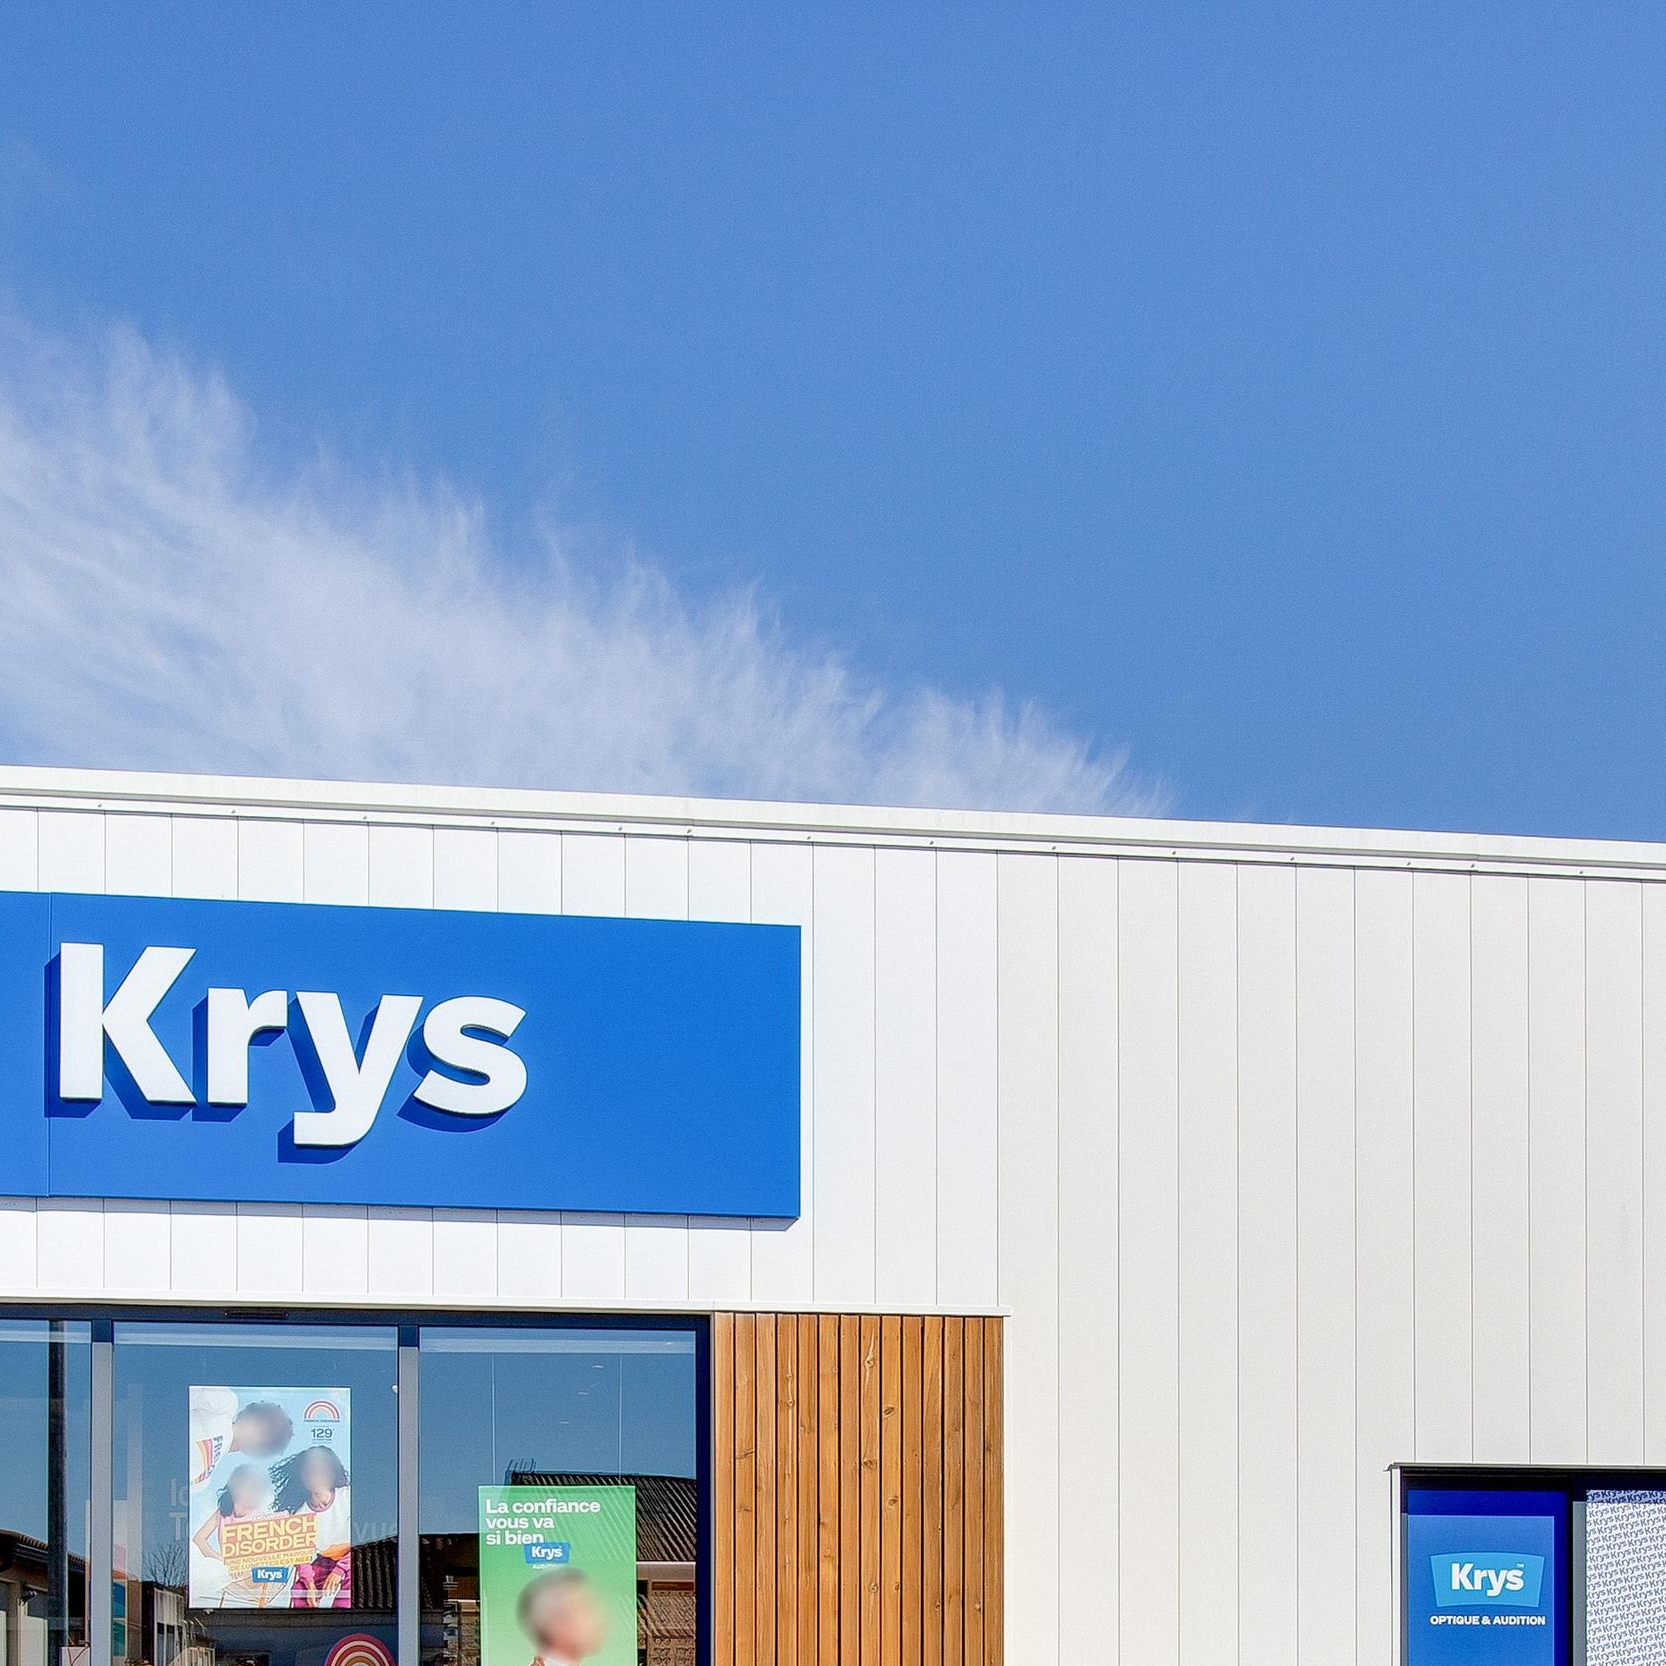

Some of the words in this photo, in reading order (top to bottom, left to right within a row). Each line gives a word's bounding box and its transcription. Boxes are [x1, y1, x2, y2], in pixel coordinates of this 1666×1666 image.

[59, 941, 529, 1146] Krys
[486, 1499, 509, 1514] La
[512, 1498, 601, 1514] confiance
[223, 1515, 317, 1544] FRENCH
[485, 1518, 529, 1529] vous
[533, 1518, 555, 1529] va
[486, 1530, 501, 1545] si
[505, 1529, 545, 1545] bien
[223, 1533, 317, 1558] DISORDER
[531, 1546, 563, 1560] Krys
[257, 1569, 283, 1581] Krys
[1451, 1562, 1525, 1597] Krys
[1430, 1615, 1480, 1626] OPTIQUE
[1481, 1615, 1491, 1626] &
[1493, 1615, 1546, 1626] AUDITION
